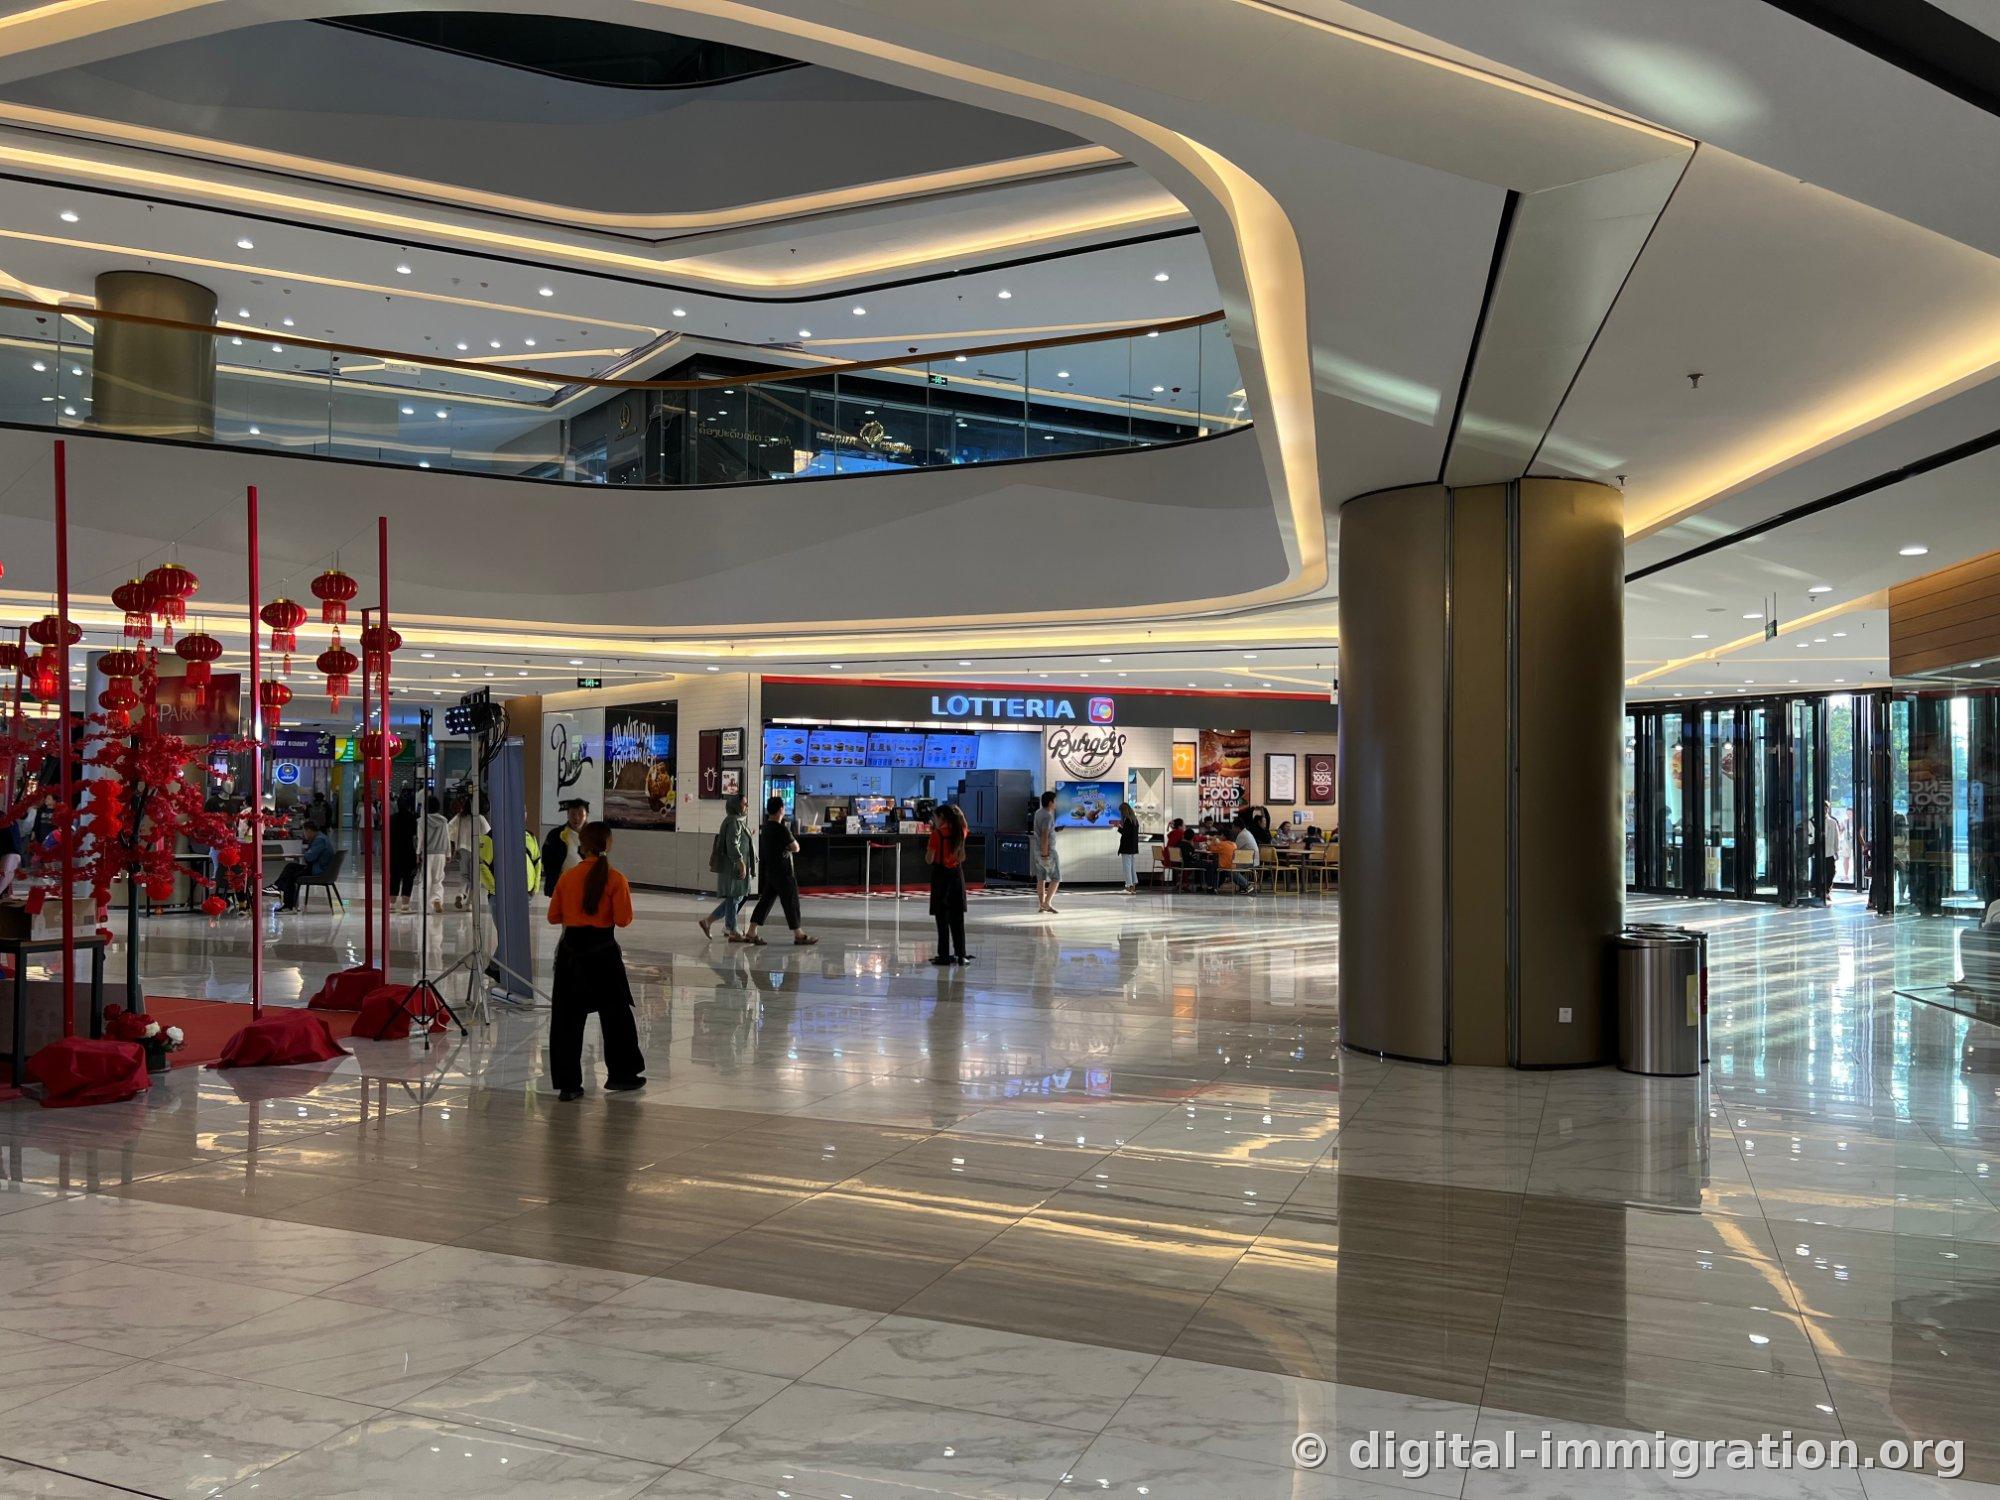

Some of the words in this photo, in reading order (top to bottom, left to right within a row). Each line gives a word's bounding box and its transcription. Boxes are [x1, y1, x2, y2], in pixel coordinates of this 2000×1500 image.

[931, 695, 1076, 719] LOTTERIA
[1048, 728, 1127, 765] Burgers
[1198, 776, 1240, 788] CIENCE
[1203, 787, 1240, 800] FOOD
